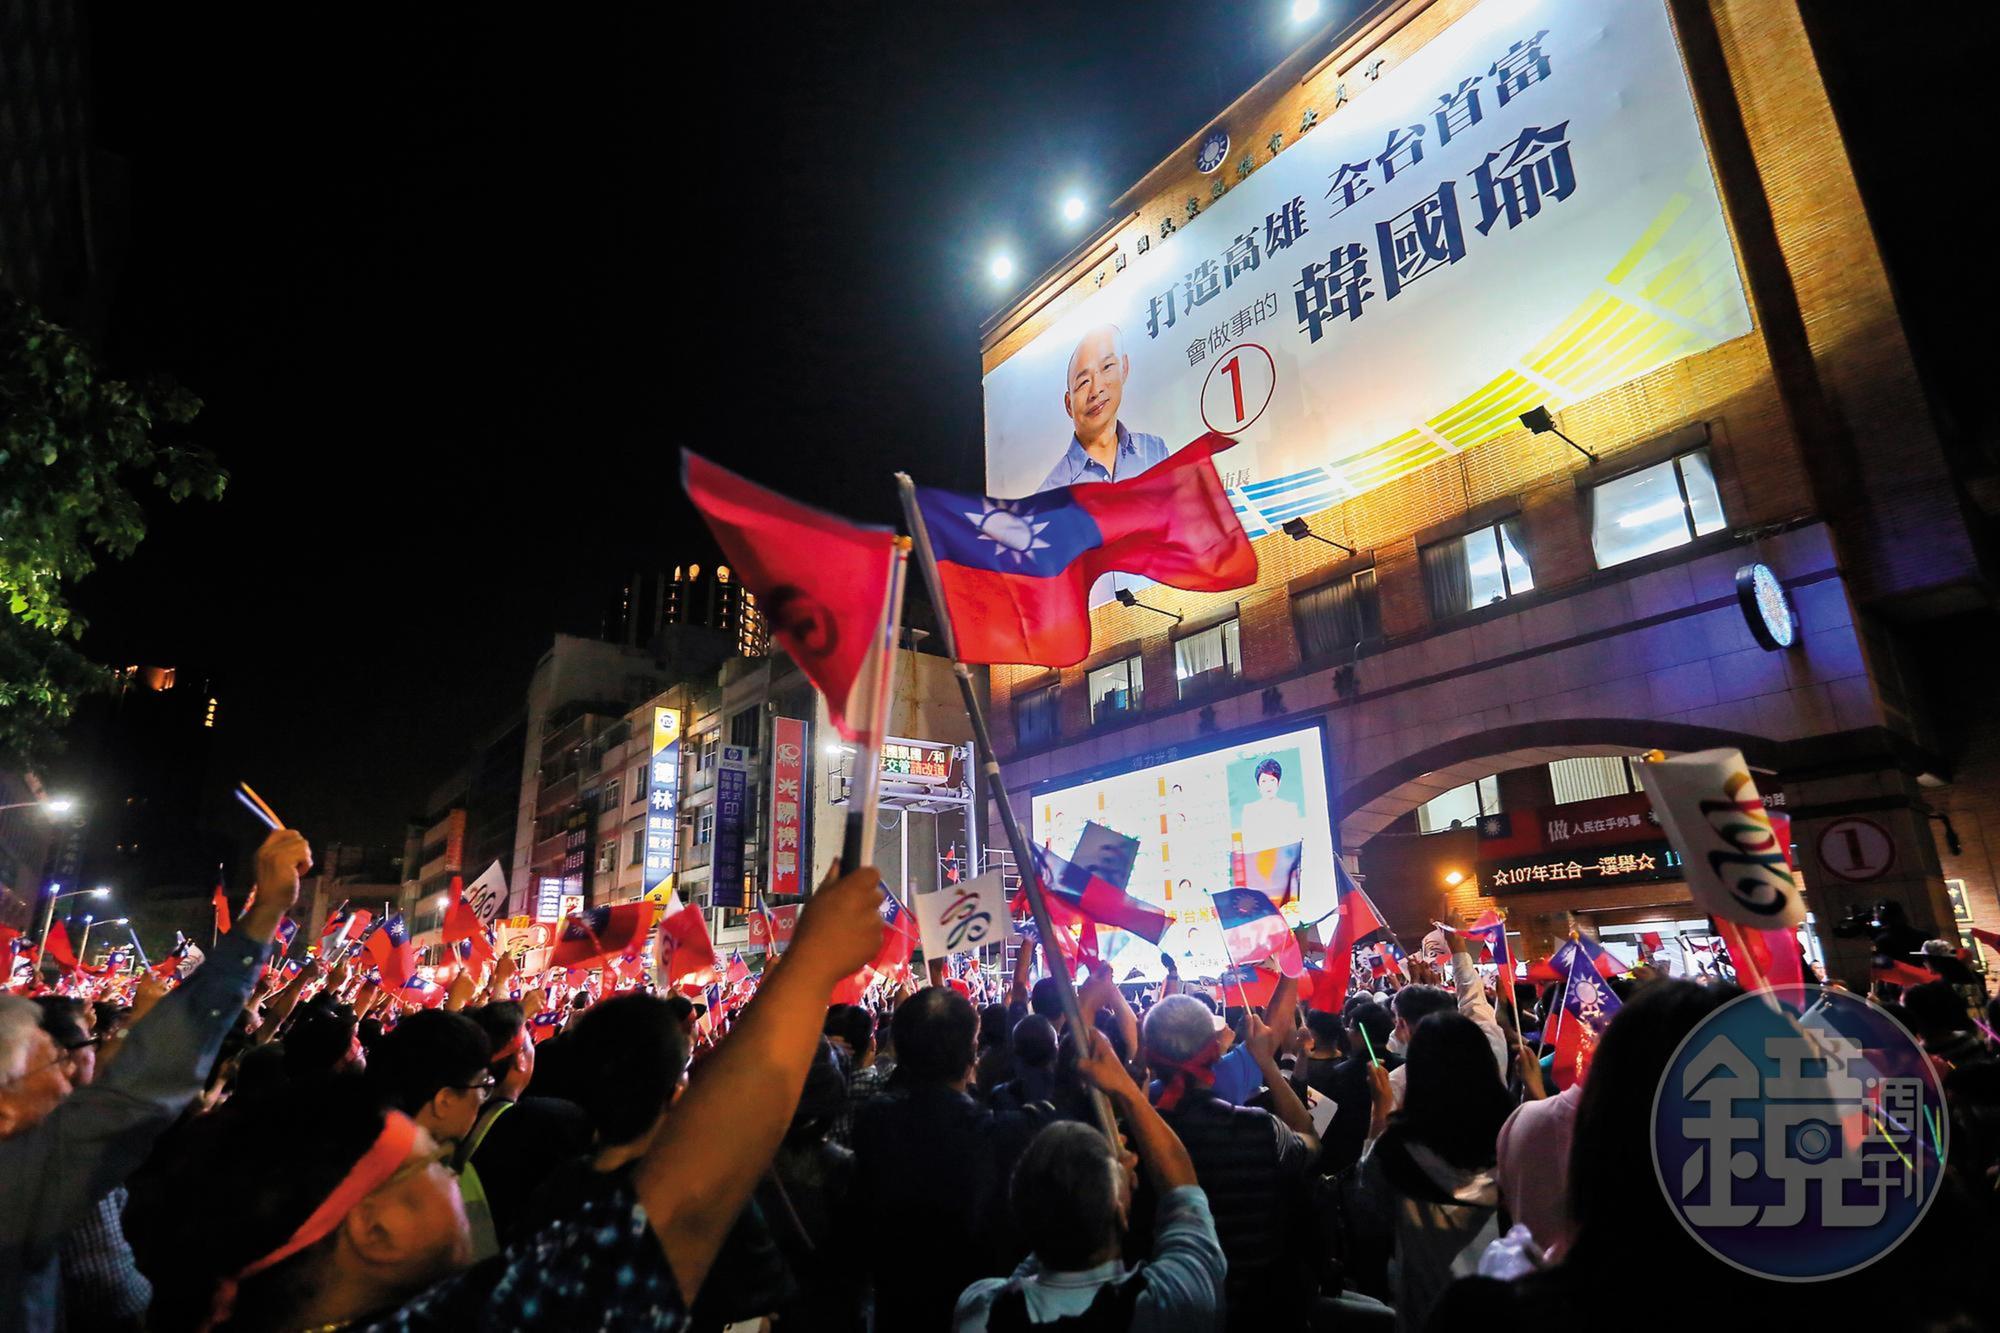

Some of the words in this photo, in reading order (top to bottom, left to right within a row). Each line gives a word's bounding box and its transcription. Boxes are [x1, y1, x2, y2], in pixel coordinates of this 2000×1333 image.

[1146, 195, 1309, 339] 打造高雄
[1324, 30, 1551, 218] 全台首富
[1186, 292, 1278, 367] 會做事的
[1293, 120, 1577, 344] 韓國瑜
[1548, 819, 1570, 842] 做
[1573, 814, 1642, 835] 人民在乎的事
